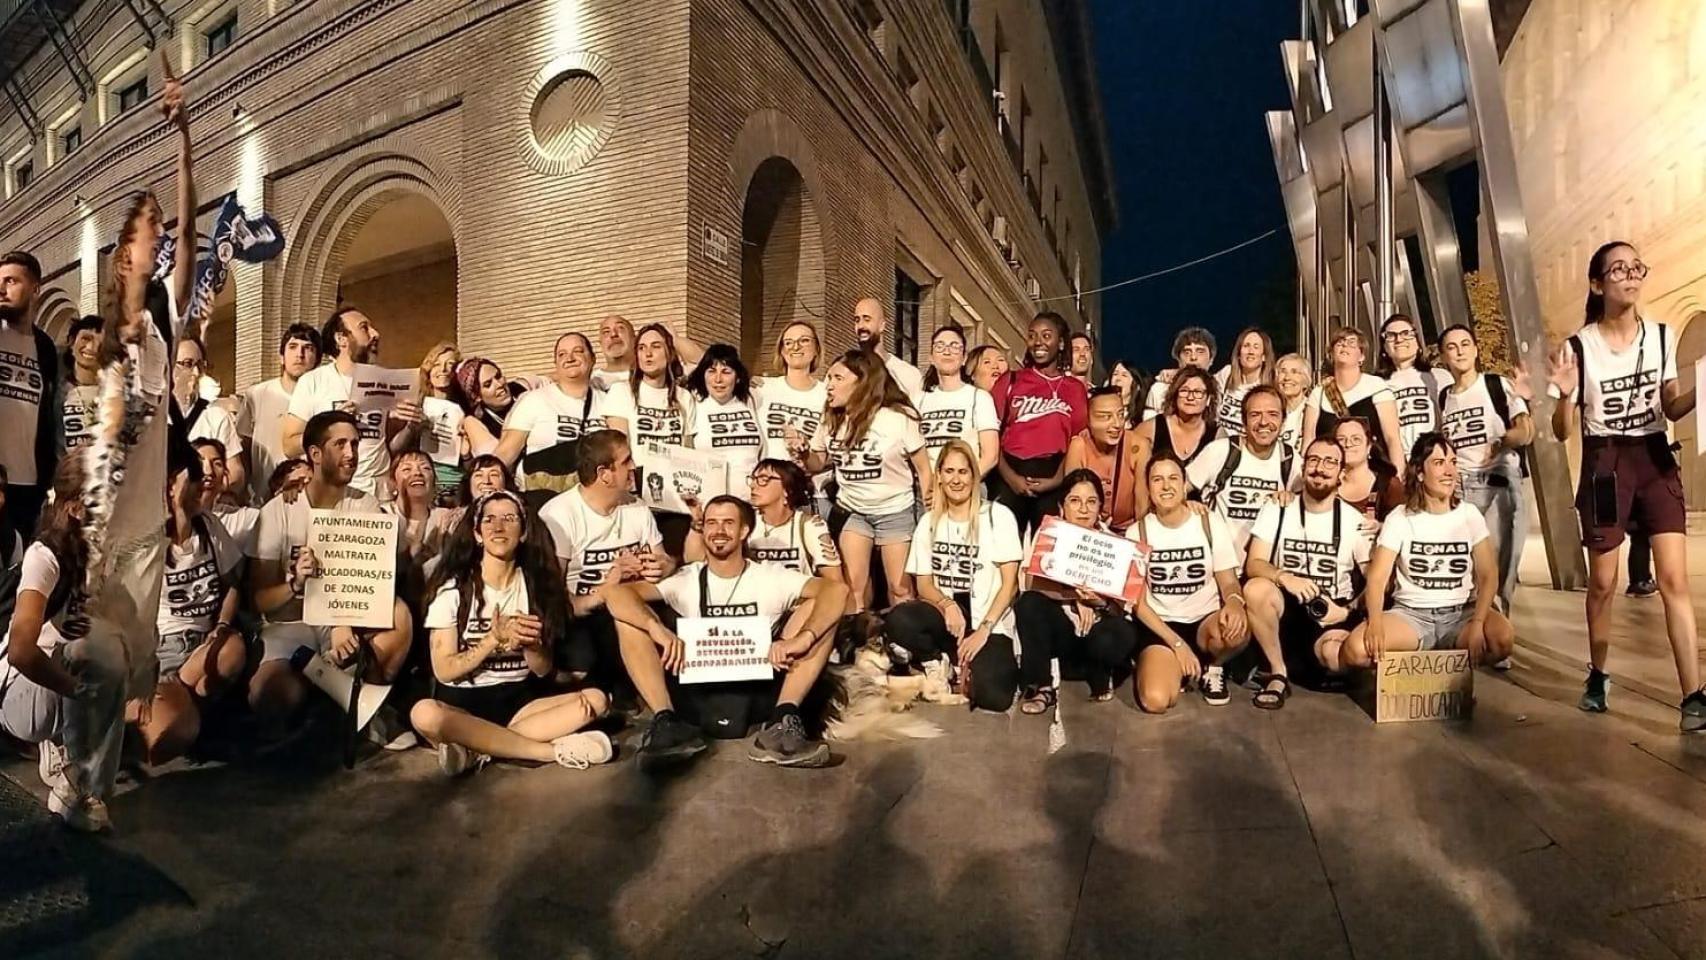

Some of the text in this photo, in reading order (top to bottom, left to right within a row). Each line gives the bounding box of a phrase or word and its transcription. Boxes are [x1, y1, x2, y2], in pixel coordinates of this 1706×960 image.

[1602, 372, 1657, 392] ZONAS
[1011, 395, 1072, 422] Miller
[710, 411, 751, 421] ZONAS
[1446, 408, 1482, 424] ONAS
[1231, 477, 1277, 489] ZONAS
[313, 516, 393, 530] AYUNTAMIENTO
[318, 533, 386, 546] DE ZARAGOZA
[1093, 539, 1113, 549] ocio
[1285, 540, 1336, 553] ZONAS
[1412, 543, 1468, 554] ZONAS
[324, 550, 377, 561] MALTRATA
[586, 552, 618, 562] ZON
[757, 550, 797, 559] ONAS
[1104, 552, 1116, 560] un
[1151, 549, 1203, 561] ZONAS
[314, 567, 393, 580] DUCADORAS/ES
[1065, 568, 1112, 586] DERECHO
[324, 584, 375, 595] DE ZONAS
[327, 599, 369, 610] JÓVENES
[708, 626, 719, 637] SÍ
[697, 647, 746, 656] DETECCIÓN
[1409, 691, 1463, 720] EDUCAT
